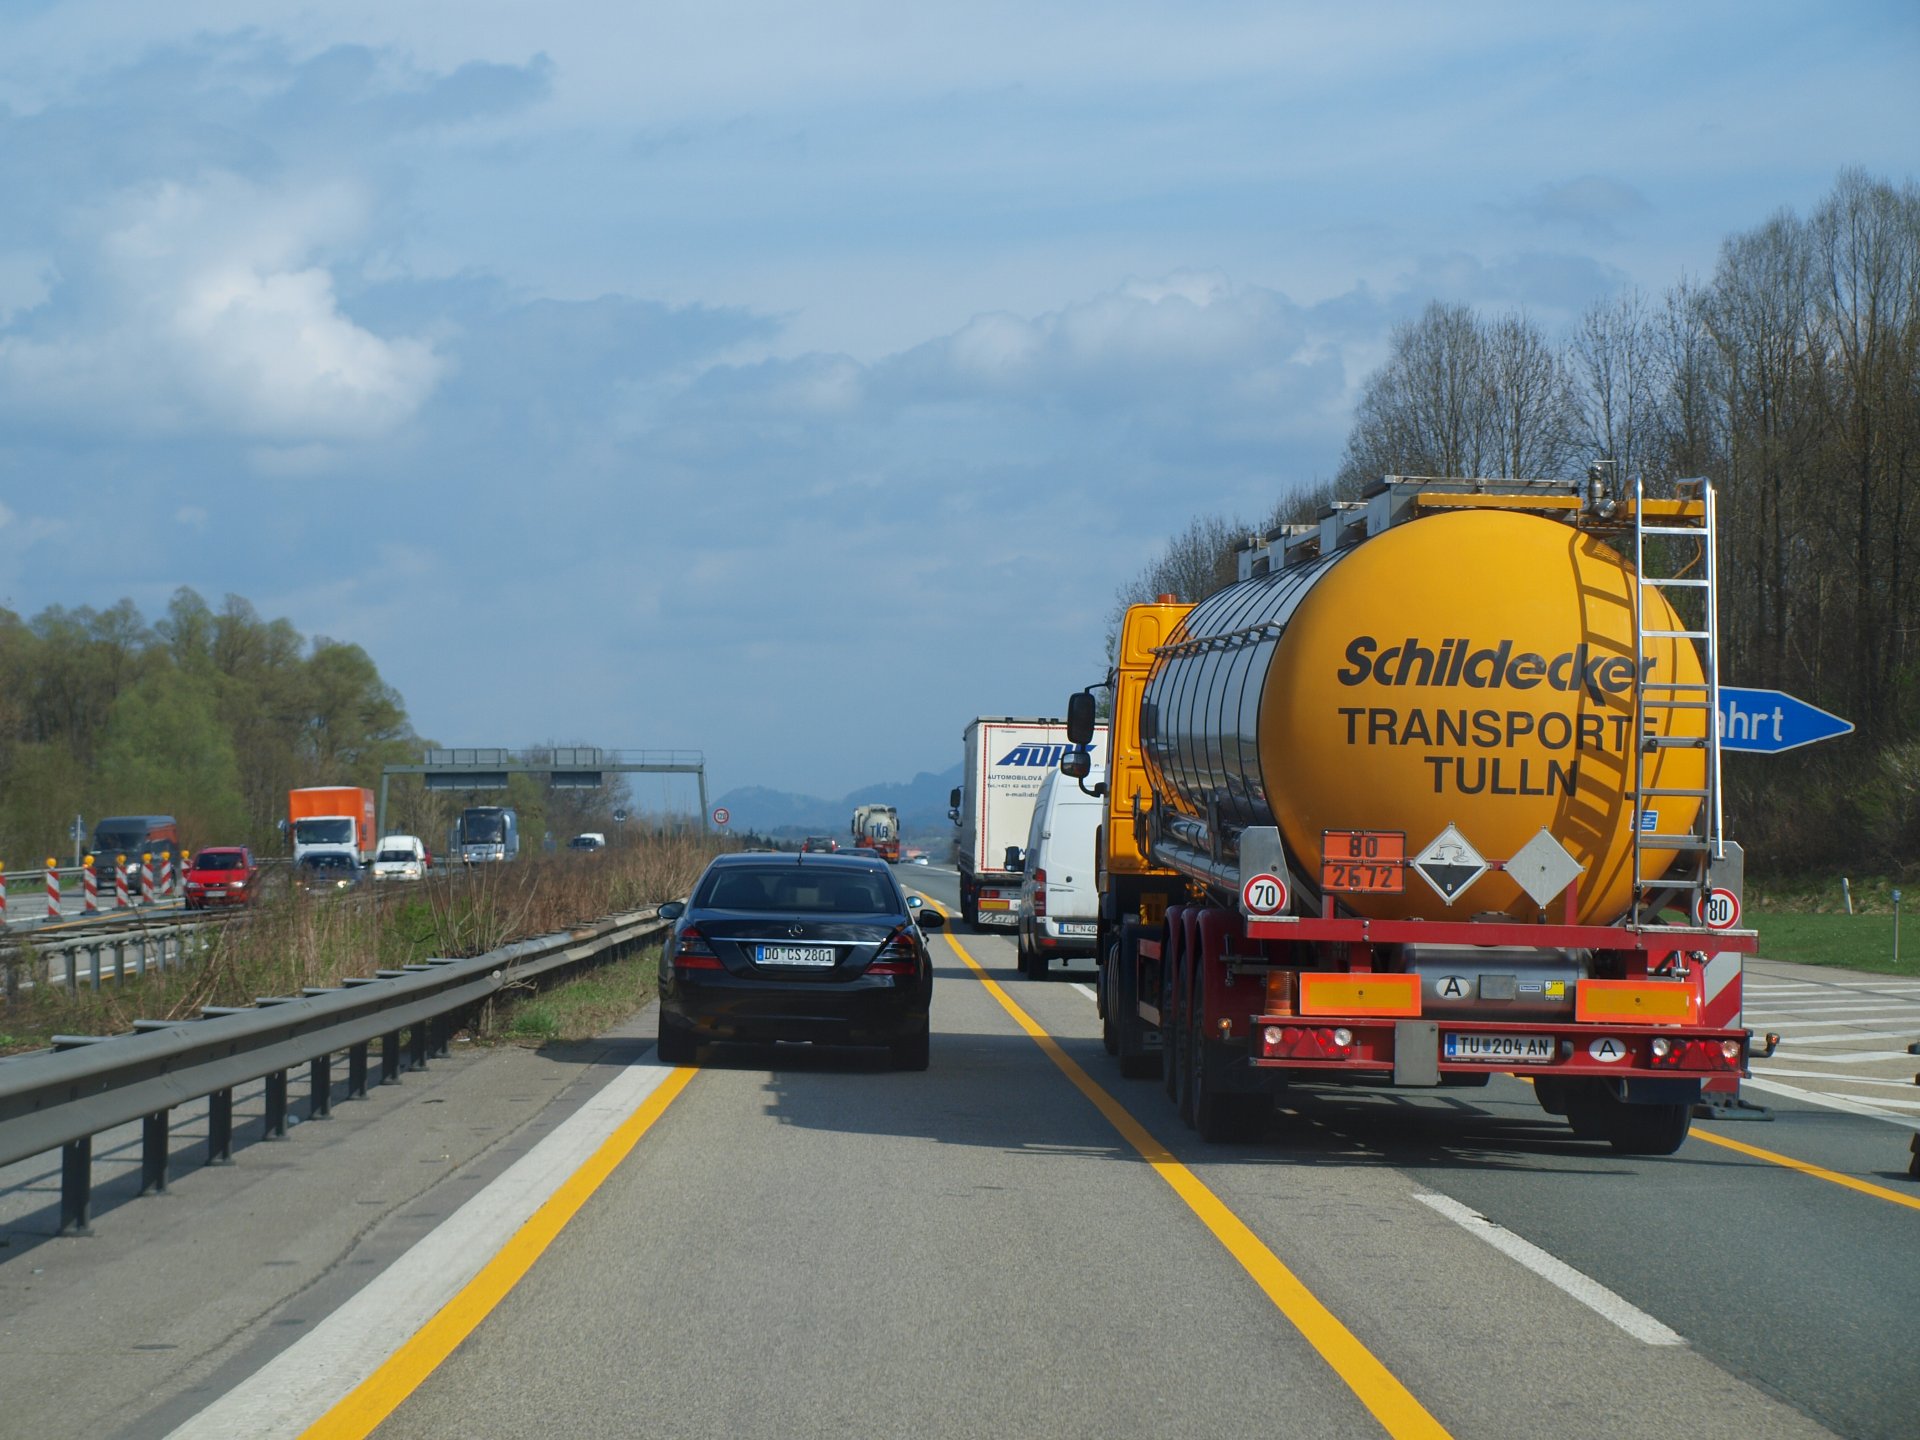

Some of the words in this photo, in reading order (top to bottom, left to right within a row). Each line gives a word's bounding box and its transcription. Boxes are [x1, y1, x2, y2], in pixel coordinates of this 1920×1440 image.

[1337, 635, 1658, 707] Schildecker
[1337, 707, 1658, 753] TRANSPORTE
[1423, 756, 1578, 797] TULLN
[1349, 835, 1378, 858] 80
[1332, 865, 1394, 889] 2672
[1255, 885, 1276, 907] 70
[1709, 899, 1728, 921] 80
[764, 947, 779, 960] DO
[787, 948, 802, 961] CS
[804, 949, 833, 962] 2801
[1444, 977, 1462, 996] A
[1459, 1037, 1480, 1053] TU
[1492, 1038, 1523, 1055] 204
[1526, 1039, 1548, 1055] AN
[1598, 1040, 1617, 1057] A
